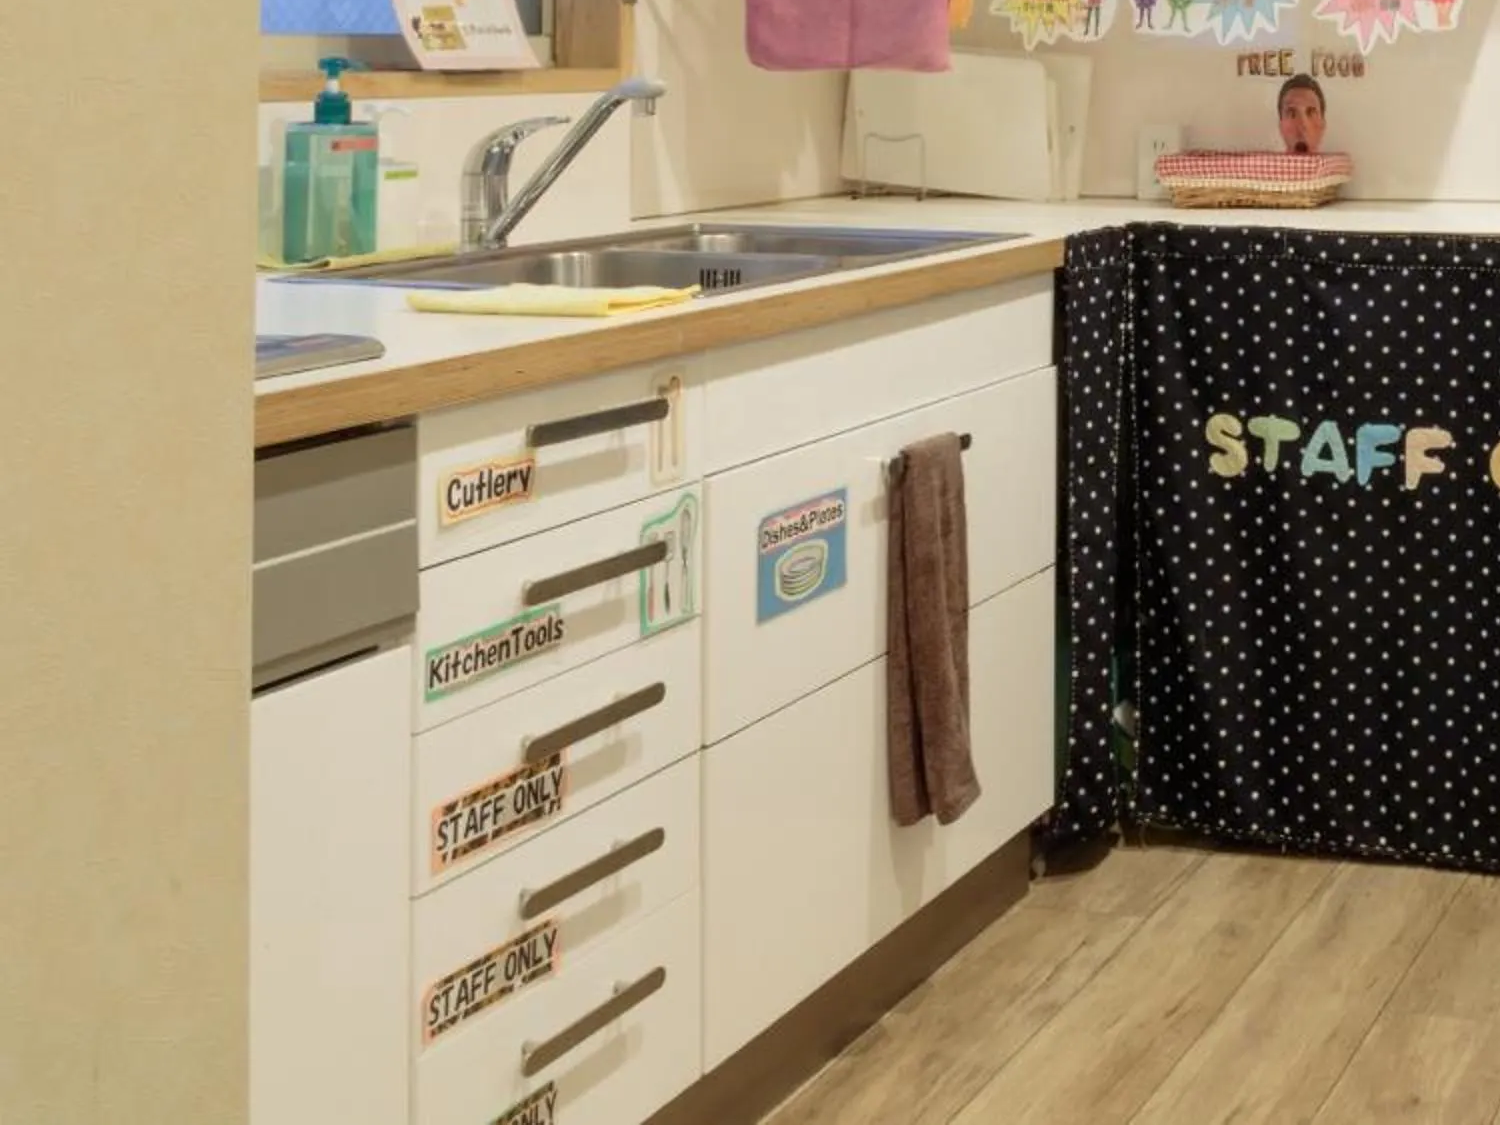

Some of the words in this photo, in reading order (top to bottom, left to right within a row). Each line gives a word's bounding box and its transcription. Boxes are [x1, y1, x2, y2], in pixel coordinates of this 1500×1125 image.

[446, 465, 532, 512] Cutlery
[1205, 413, 1453, 491] STAFF
[427, 614, 564, 690] KitchenTools
[436, 793, 506, 853] STAFF
[513, 766, 563, 818] ONLY
[428, 963, 498, 1027] STAFF
[503, 927, 558, 981] ONLY
[511, 1087, 559, 1125] NLY
